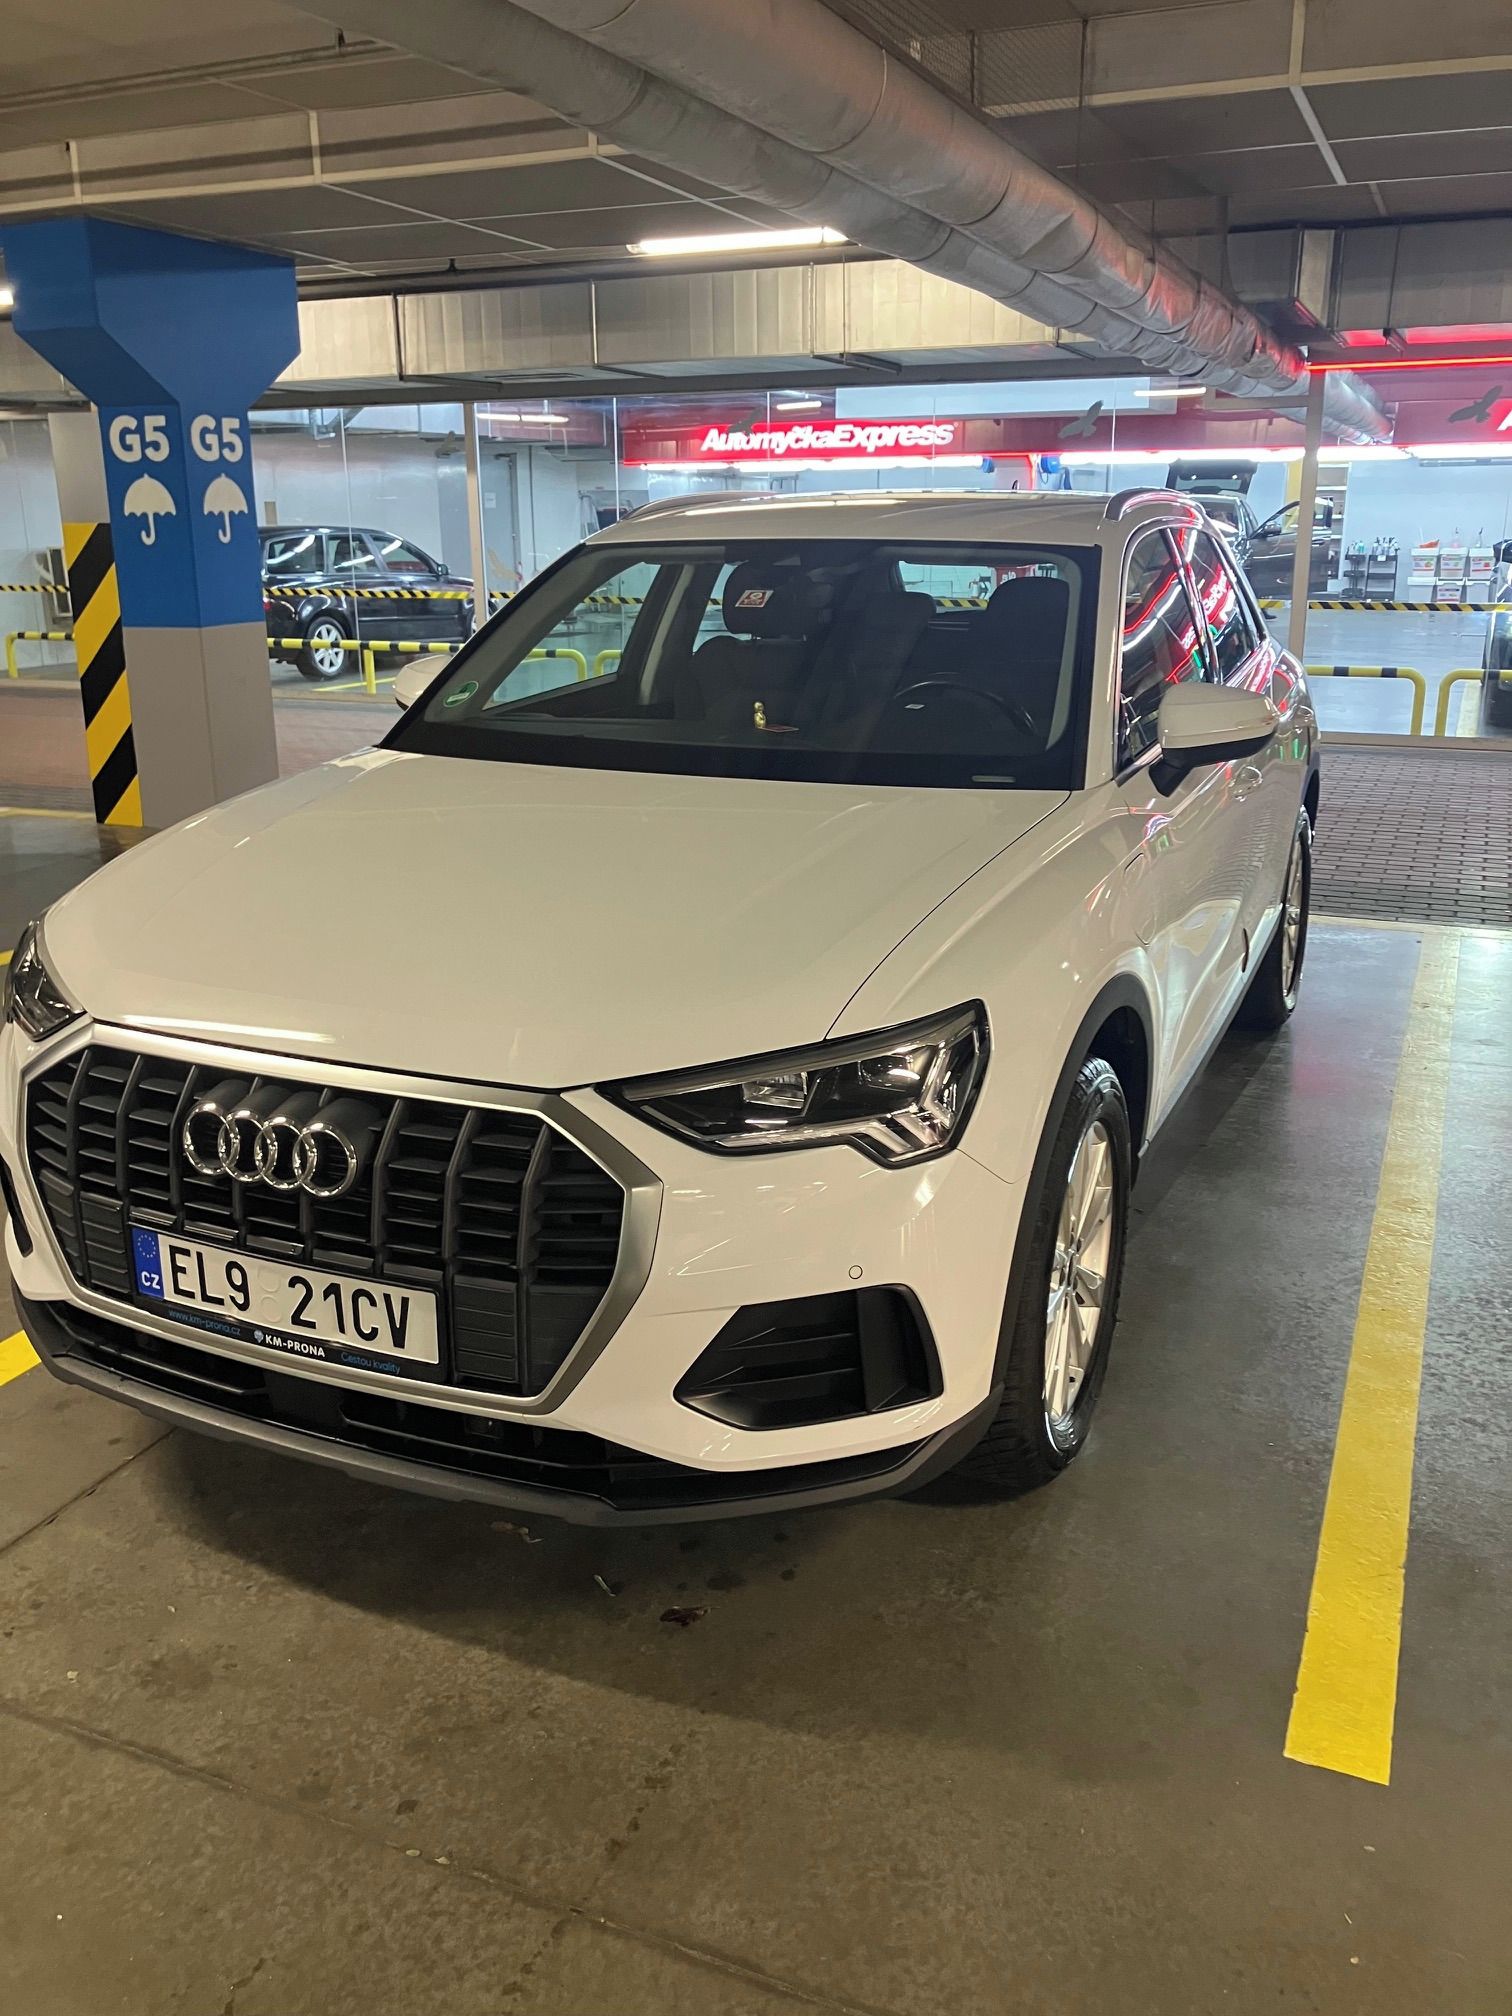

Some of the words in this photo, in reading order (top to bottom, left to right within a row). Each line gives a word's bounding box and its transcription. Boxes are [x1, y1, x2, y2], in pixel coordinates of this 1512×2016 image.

[109, 414, 170, 463] G5
[190, 413, 243, 463] G5
[141, 1270, 161, 1290] CZ
[168, 1244, 251, 1312] EL9
[287, 1275, 410, 1350] 21CV
[169, 1309, 241, 1336] www.km-prona.cz
[265, 1334, 325, 1357] KM-PRONA
